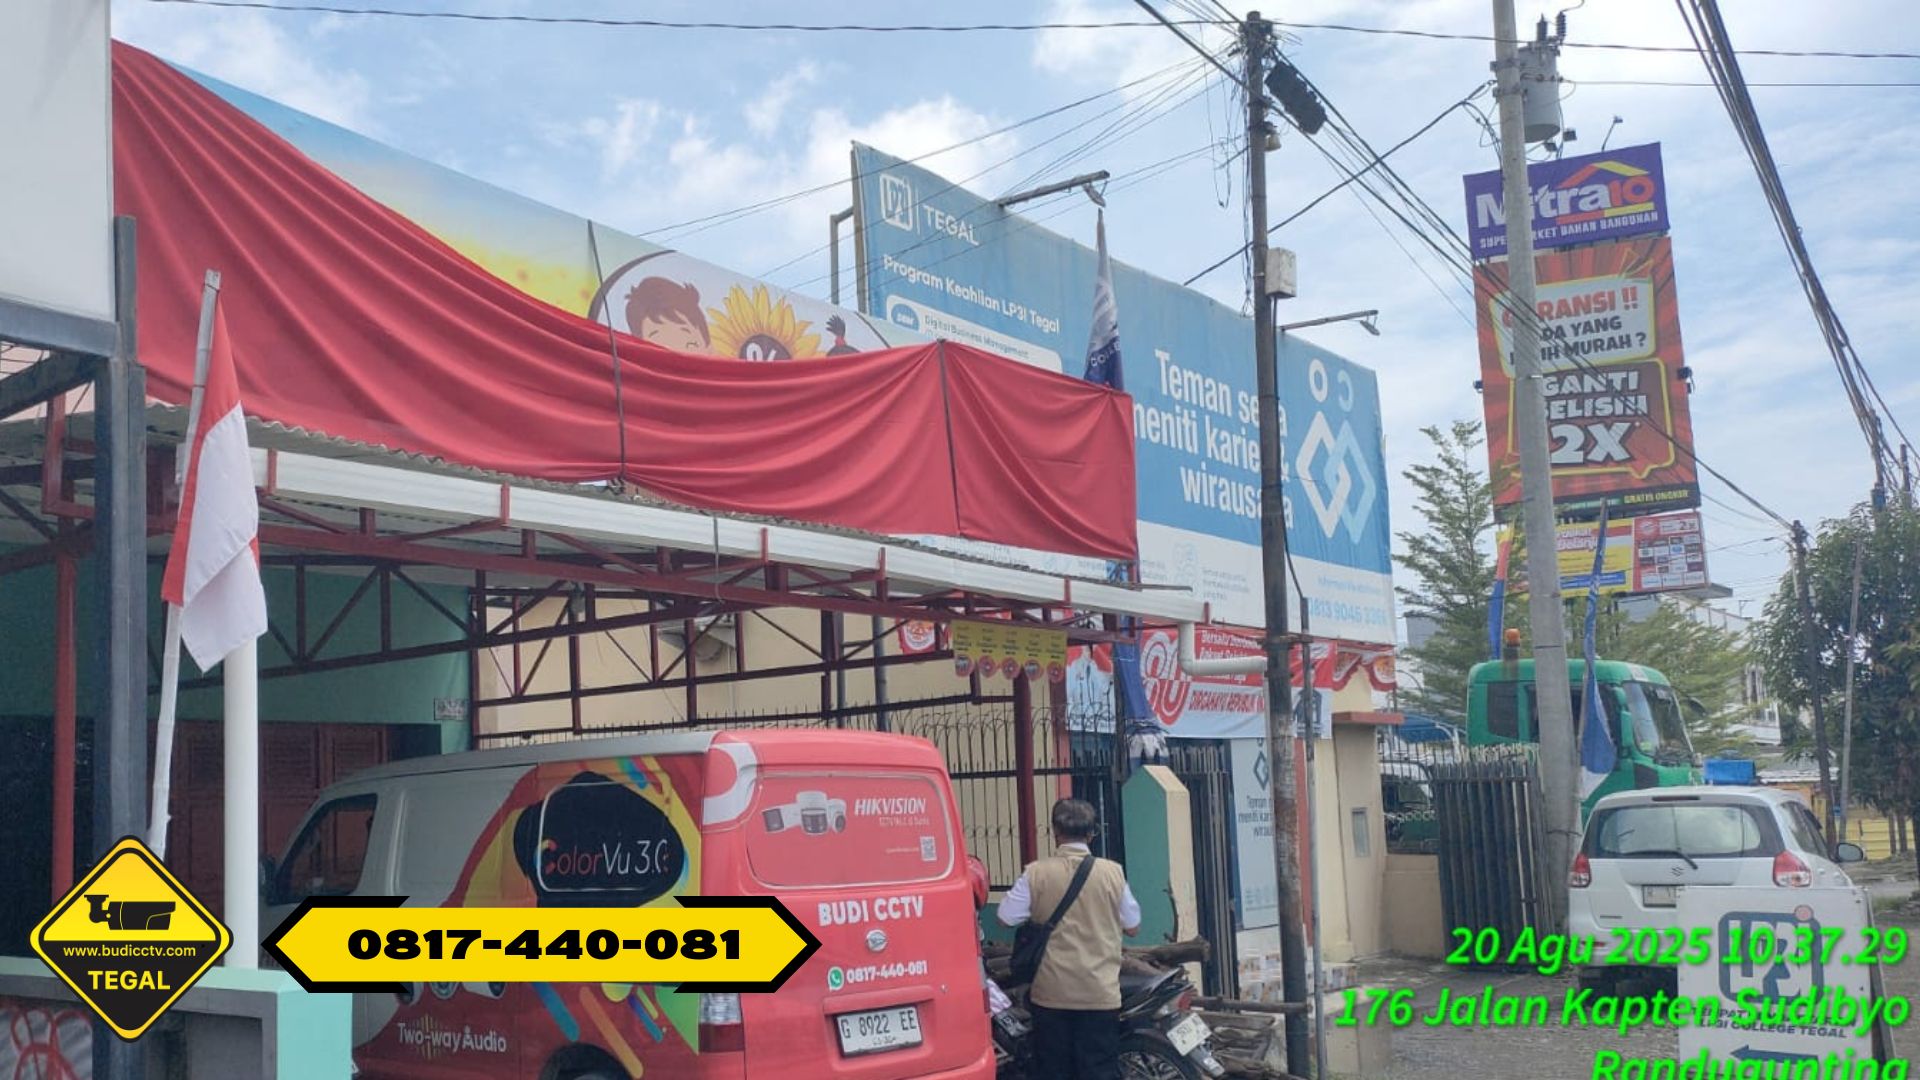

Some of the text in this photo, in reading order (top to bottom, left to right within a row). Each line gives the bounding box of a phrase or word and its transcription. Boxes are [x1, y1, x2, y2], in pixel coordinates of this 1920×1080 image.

[923, 205, 979, 246] TEGAL
[1480, 210, 1659, 249] SUPERKET BAHAN BANGUNAN
[883, 253, 1060, 336] Program Keahlian LP3I Tegal
[924, 313, 951, 334] Digital
[1538, 315, 1623, 342] DA YANG
[1563, 334, 1633, 357] MURAH
[1155, 349, 1289, 437] Teman sea
[1543, 370, 1640, 396] GANTI
[1205, 415, 1262, 475] karie
[1550, 421, 1633, 465] 2X
[1180, 461, 1294, 528] wirausa
[854, 798, 927, 817] HIKVISION
[818, 894, 925, 928] BUDI CCTV
[846, 960, 928, 984] 0817-440-081
[840, 1010, 917, 1039] G 8922 EE
[1730, 1019, 1796, 1036] COLLEGE
[1800, 1026, 1847, 1039] TEGAL
